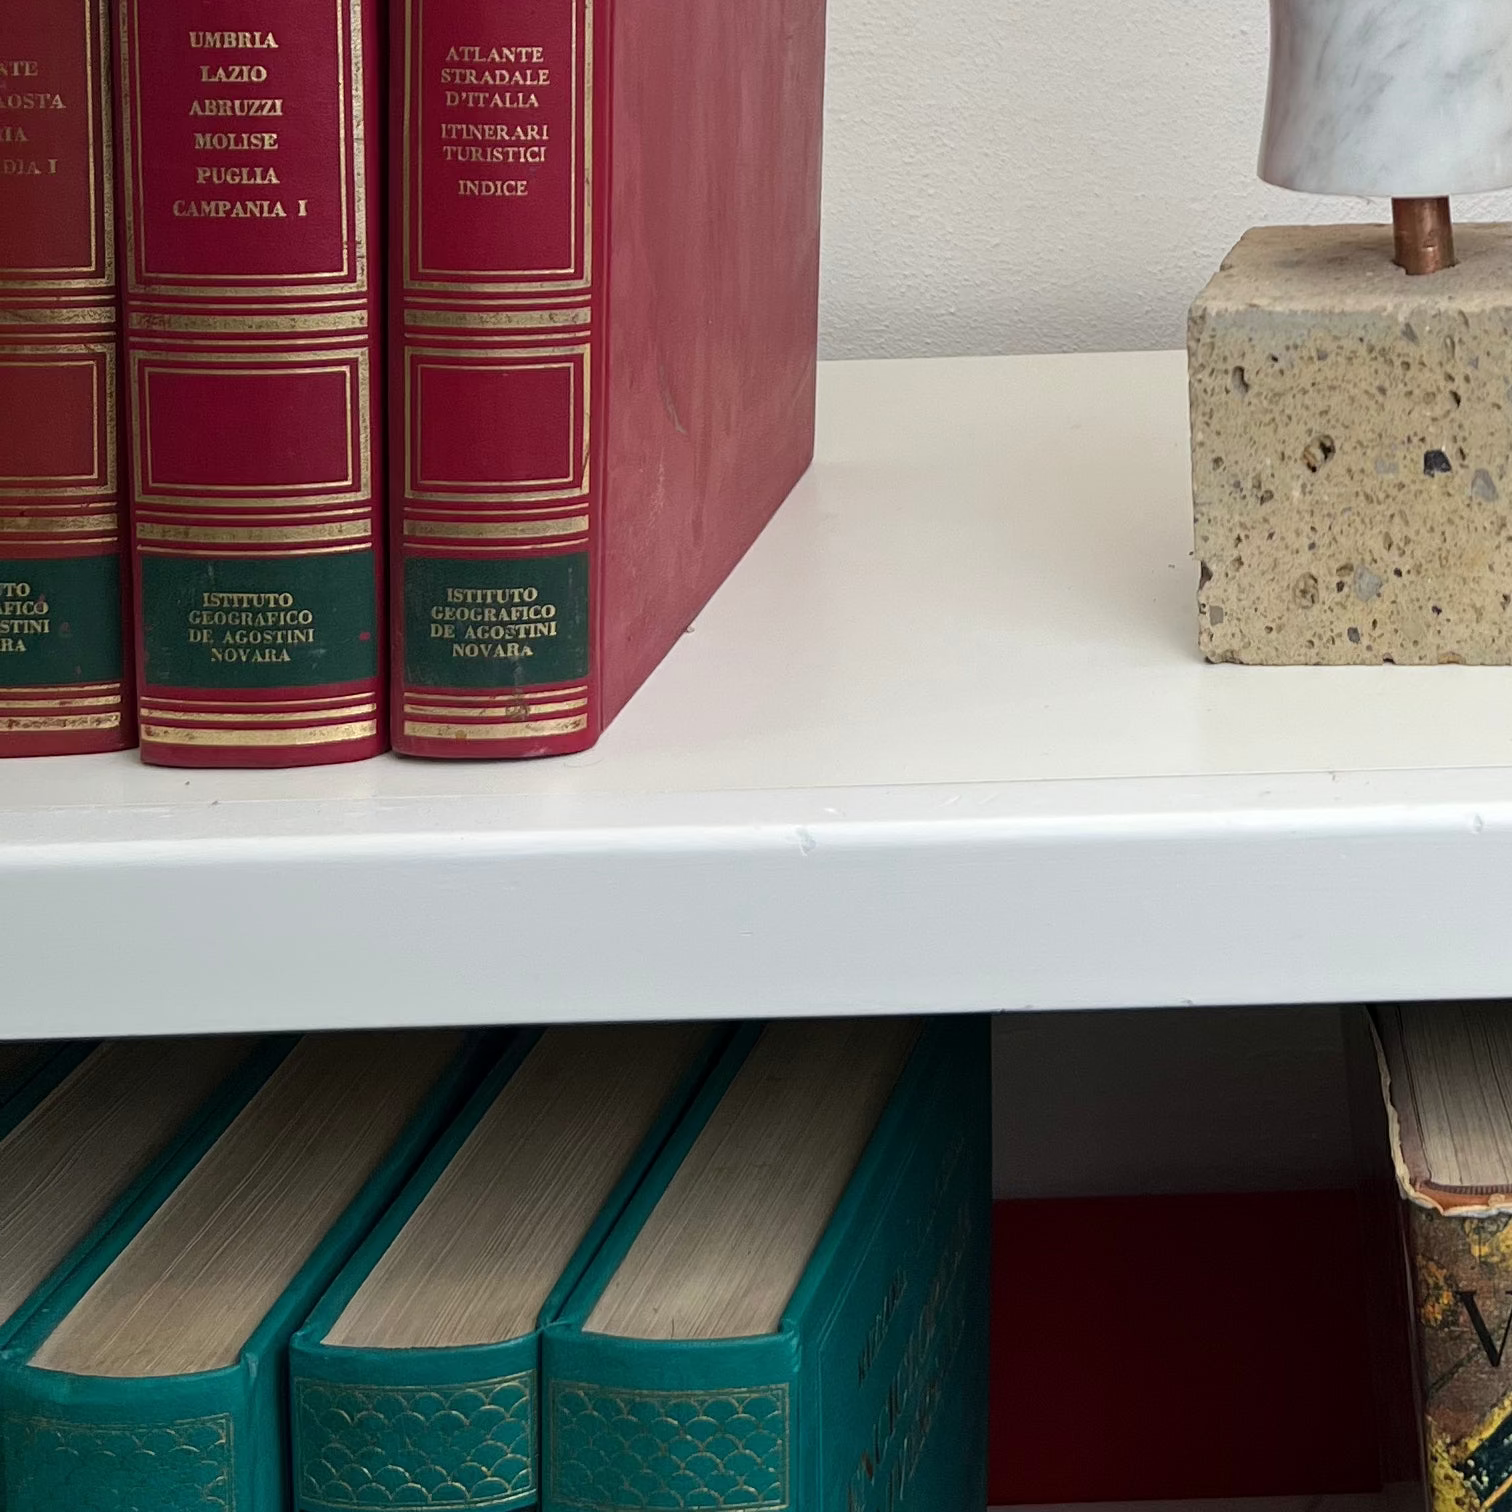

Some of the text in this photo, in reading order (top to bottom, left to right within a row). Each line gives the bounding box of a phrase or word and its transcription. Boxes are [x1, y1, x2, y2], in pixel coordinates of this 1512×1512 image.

[189, 32, 278, 49] UMBRIA
[446, 47, 543, 63] ATLANTE
[201, 66, 267, 82] LAZIO
[441, 69, 550, 85] STRADALE
[189, 99, 282, 116] ABRUZZI
[446, 92, 538, 108] D'ITALIA
[441, 124, 549, 140] ITINERARI
[194, 133, 278, 149] MOLISE
[443, 146, 546, 162] TURISTICI
[197, 167, 279, 184] PUGLIA
[458, 180, 528, 196] INDICE
[173, 200, 308, 217] CAMPANIA I
[202, 593, 293, 608] ISTITUTO
[447, 588, 538, 603] ISTITUTO
[188, 610, 312, 626] GEOGRAFICO
[431, 604, 555, 622] GEOGRAFICO
[188, 628, 314, 644] DE AGOSTINI
[431, 621, 557, 639] DE AGOSTINI
[211, 648, 290, 662] NOVARA
[452, 642, 532, 657] NOVARA
